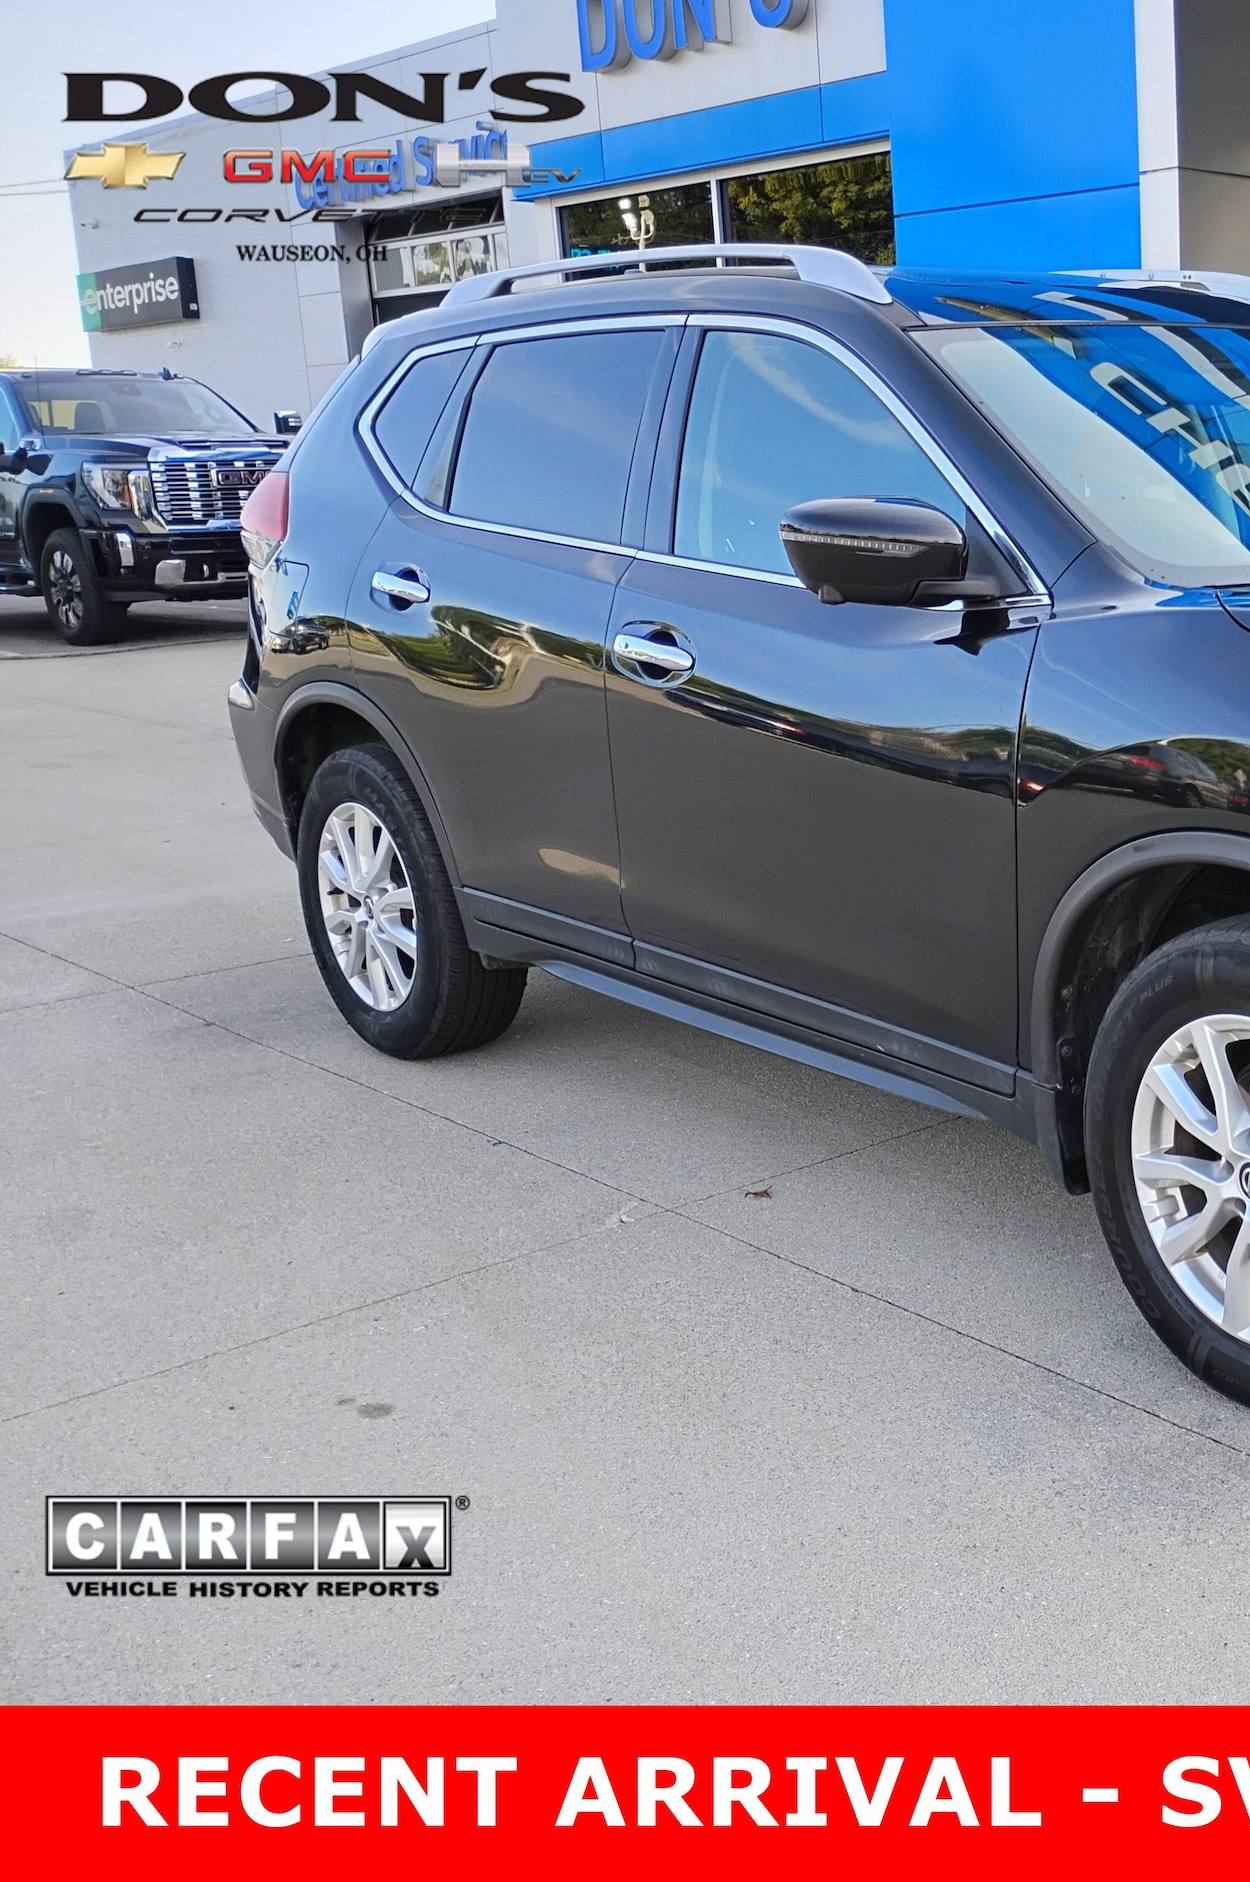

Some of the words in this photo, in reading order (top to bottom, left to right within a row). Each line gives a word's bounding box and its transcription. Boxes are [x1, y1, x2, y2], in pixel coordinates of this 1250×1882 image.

[81, 272, 179, 314] enterprise
[218, 470, 271, 485] GM
[1139, 974, 1174, 1004] PLUS
